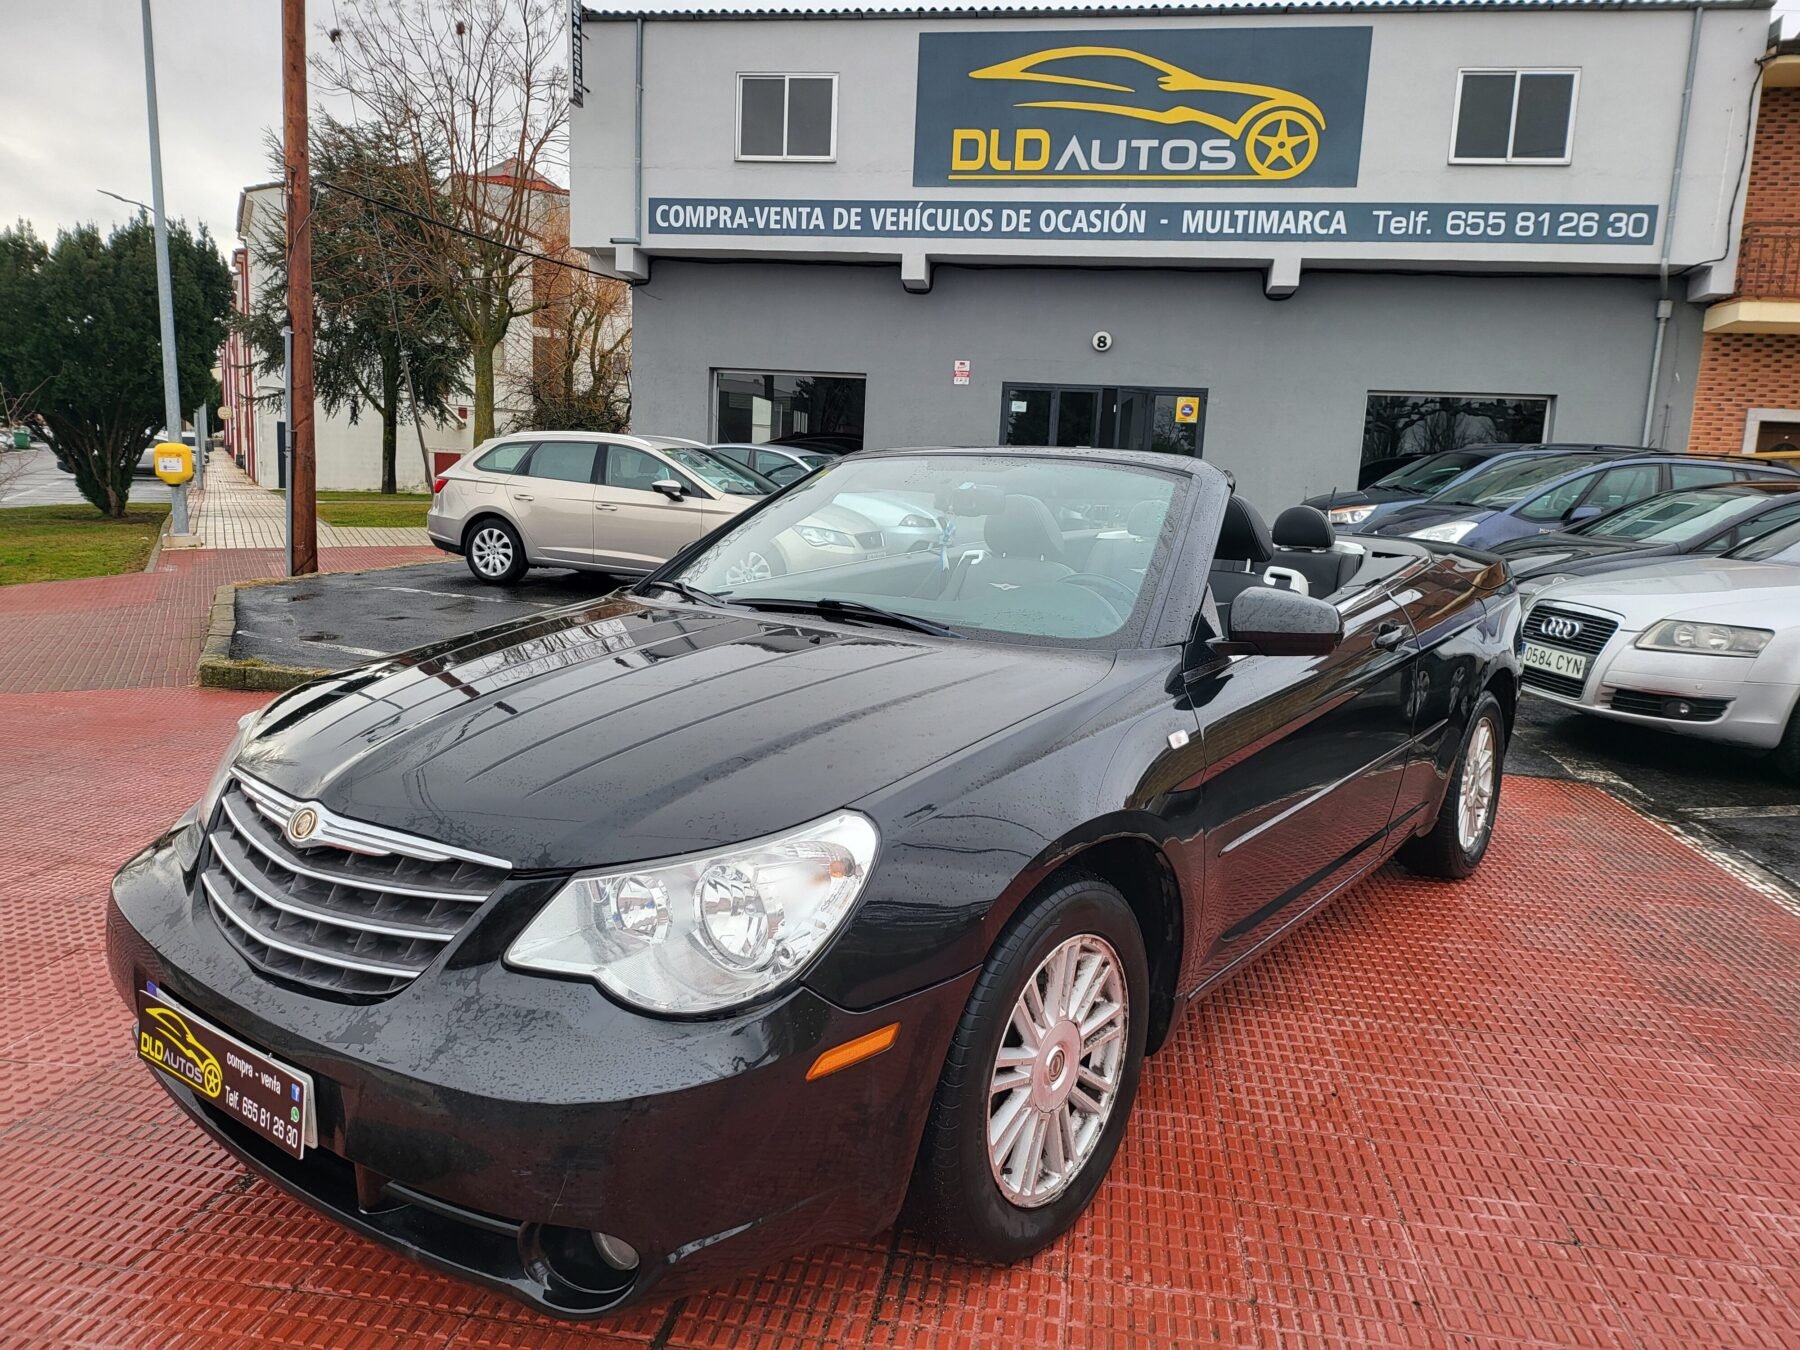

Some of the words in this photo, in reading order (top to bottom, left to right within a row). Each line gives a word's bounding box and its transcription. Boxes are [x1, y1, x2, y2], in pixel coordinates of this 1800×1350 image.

[951, 128, 1051, 171] DLD
[1055, 135, 1237, 171] AUTOS
[655, 204, 825, 230] COMPRA-VENTA
[833, 207, 862, 231] DE
[870, 201, 994, 232] VEHÍCULOS
[1001, 209, 1032, 232] DE
[1039, 203, 1146, 233] OCASIÓN
[1182, 209, 1347, 235] MULTIMARCA
[1372, 210, 1432, 235] Telf.
[1446, 210, 1507, 236] 655
[1515, 211, 1551, 236] 81
[1557, 211, 1600, 237] 26
[1607, 212, 1649, 238] 30
[1096, 335, 1108, 349] 8
[1525, 647, 1553, 668] 0584
[1556, 655, 1583, 675] CYN
[141, 1032, 164, 1061] DLD
[163, 1048, 203, 1084] AUTOS
[226, 1051, 253, 1078] compra
[260, 1071, 281, 1095] venta
[224, 1085, 239, 1111] Telf.
[242, 1096, 258, 1123] 655
[259, 1107, 270, 1131] 81
[272, 1115, 285, 1140] 26
[285, 1124, 298, 1149] 30
